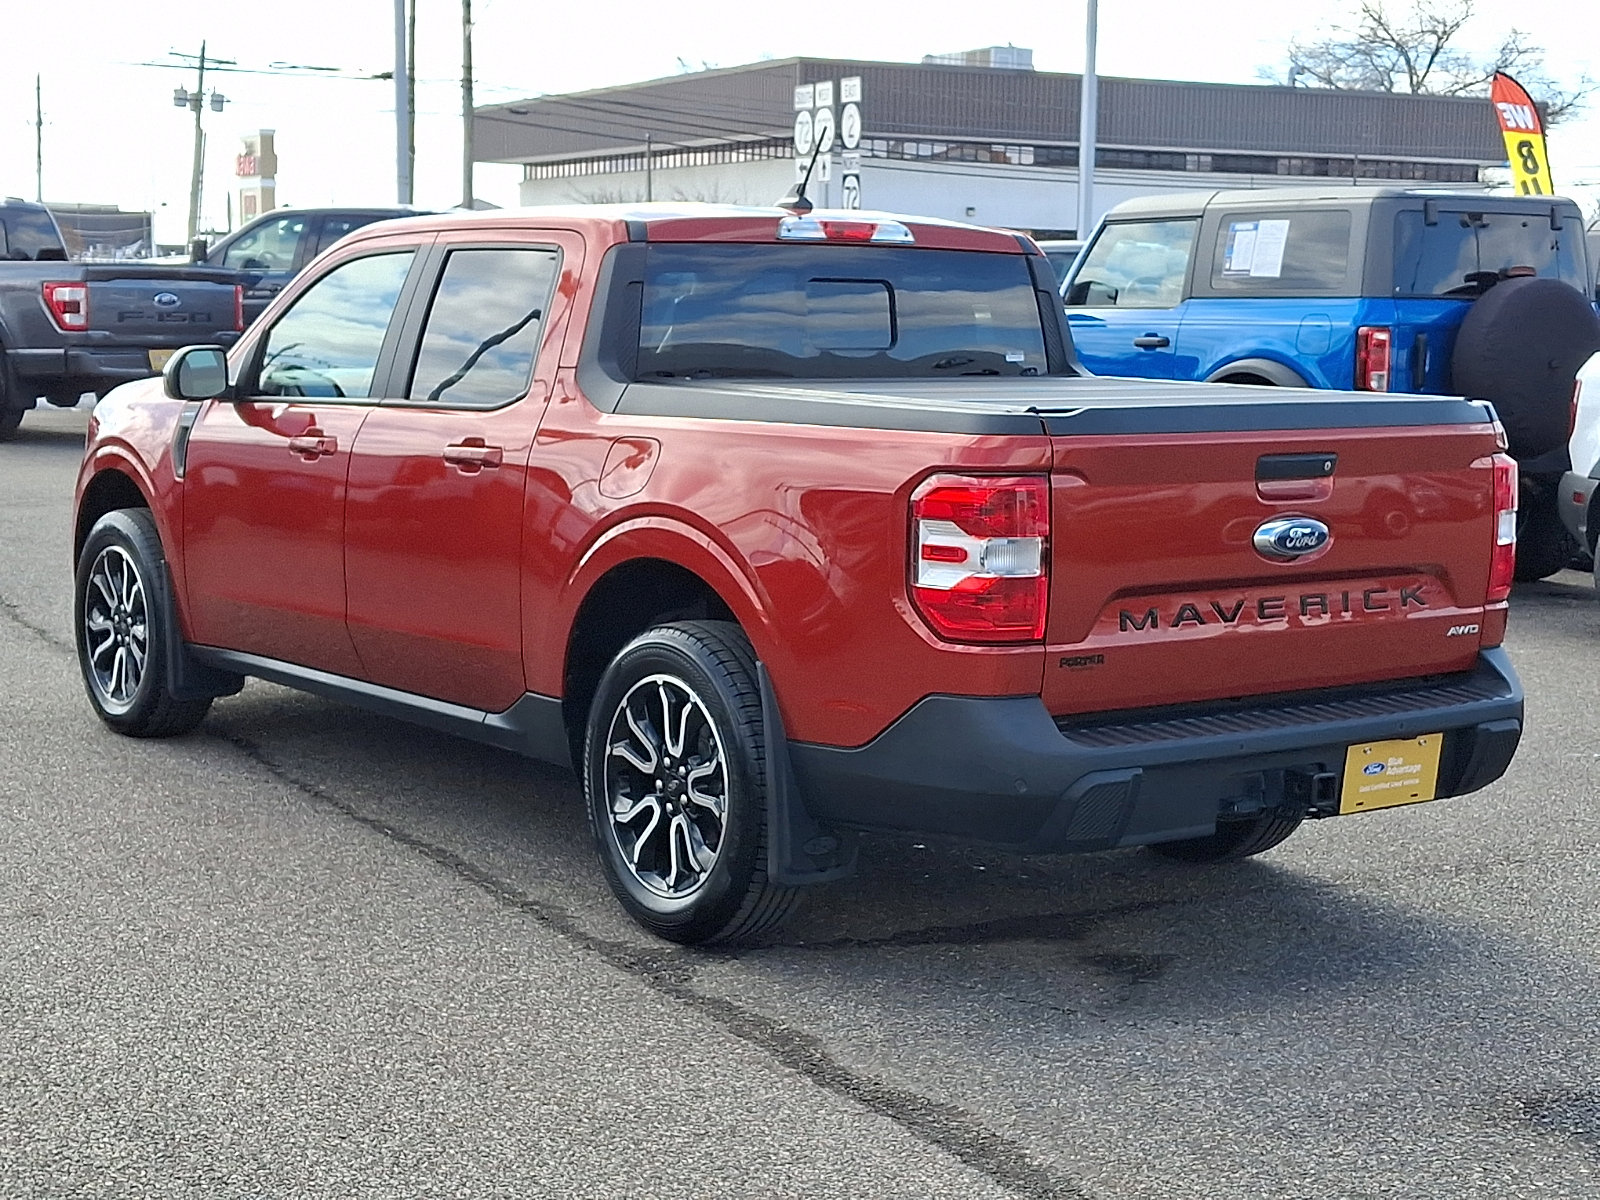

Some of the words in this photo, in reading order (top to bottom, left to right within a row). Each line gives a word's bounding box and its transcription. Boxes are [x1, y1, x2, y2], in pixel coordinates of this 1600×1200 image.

[847, 113, 856, 138] 2
[845, 186, 858, 209] 72
[118, 311, 212, 323] F-150
[1286, 527, 1319, 549] Ford
[1118, 584, 1429, 632] MAVERICK
[1446, 624, 1480, 637] AWD
[1365, 763, 1384, 775] Ford
